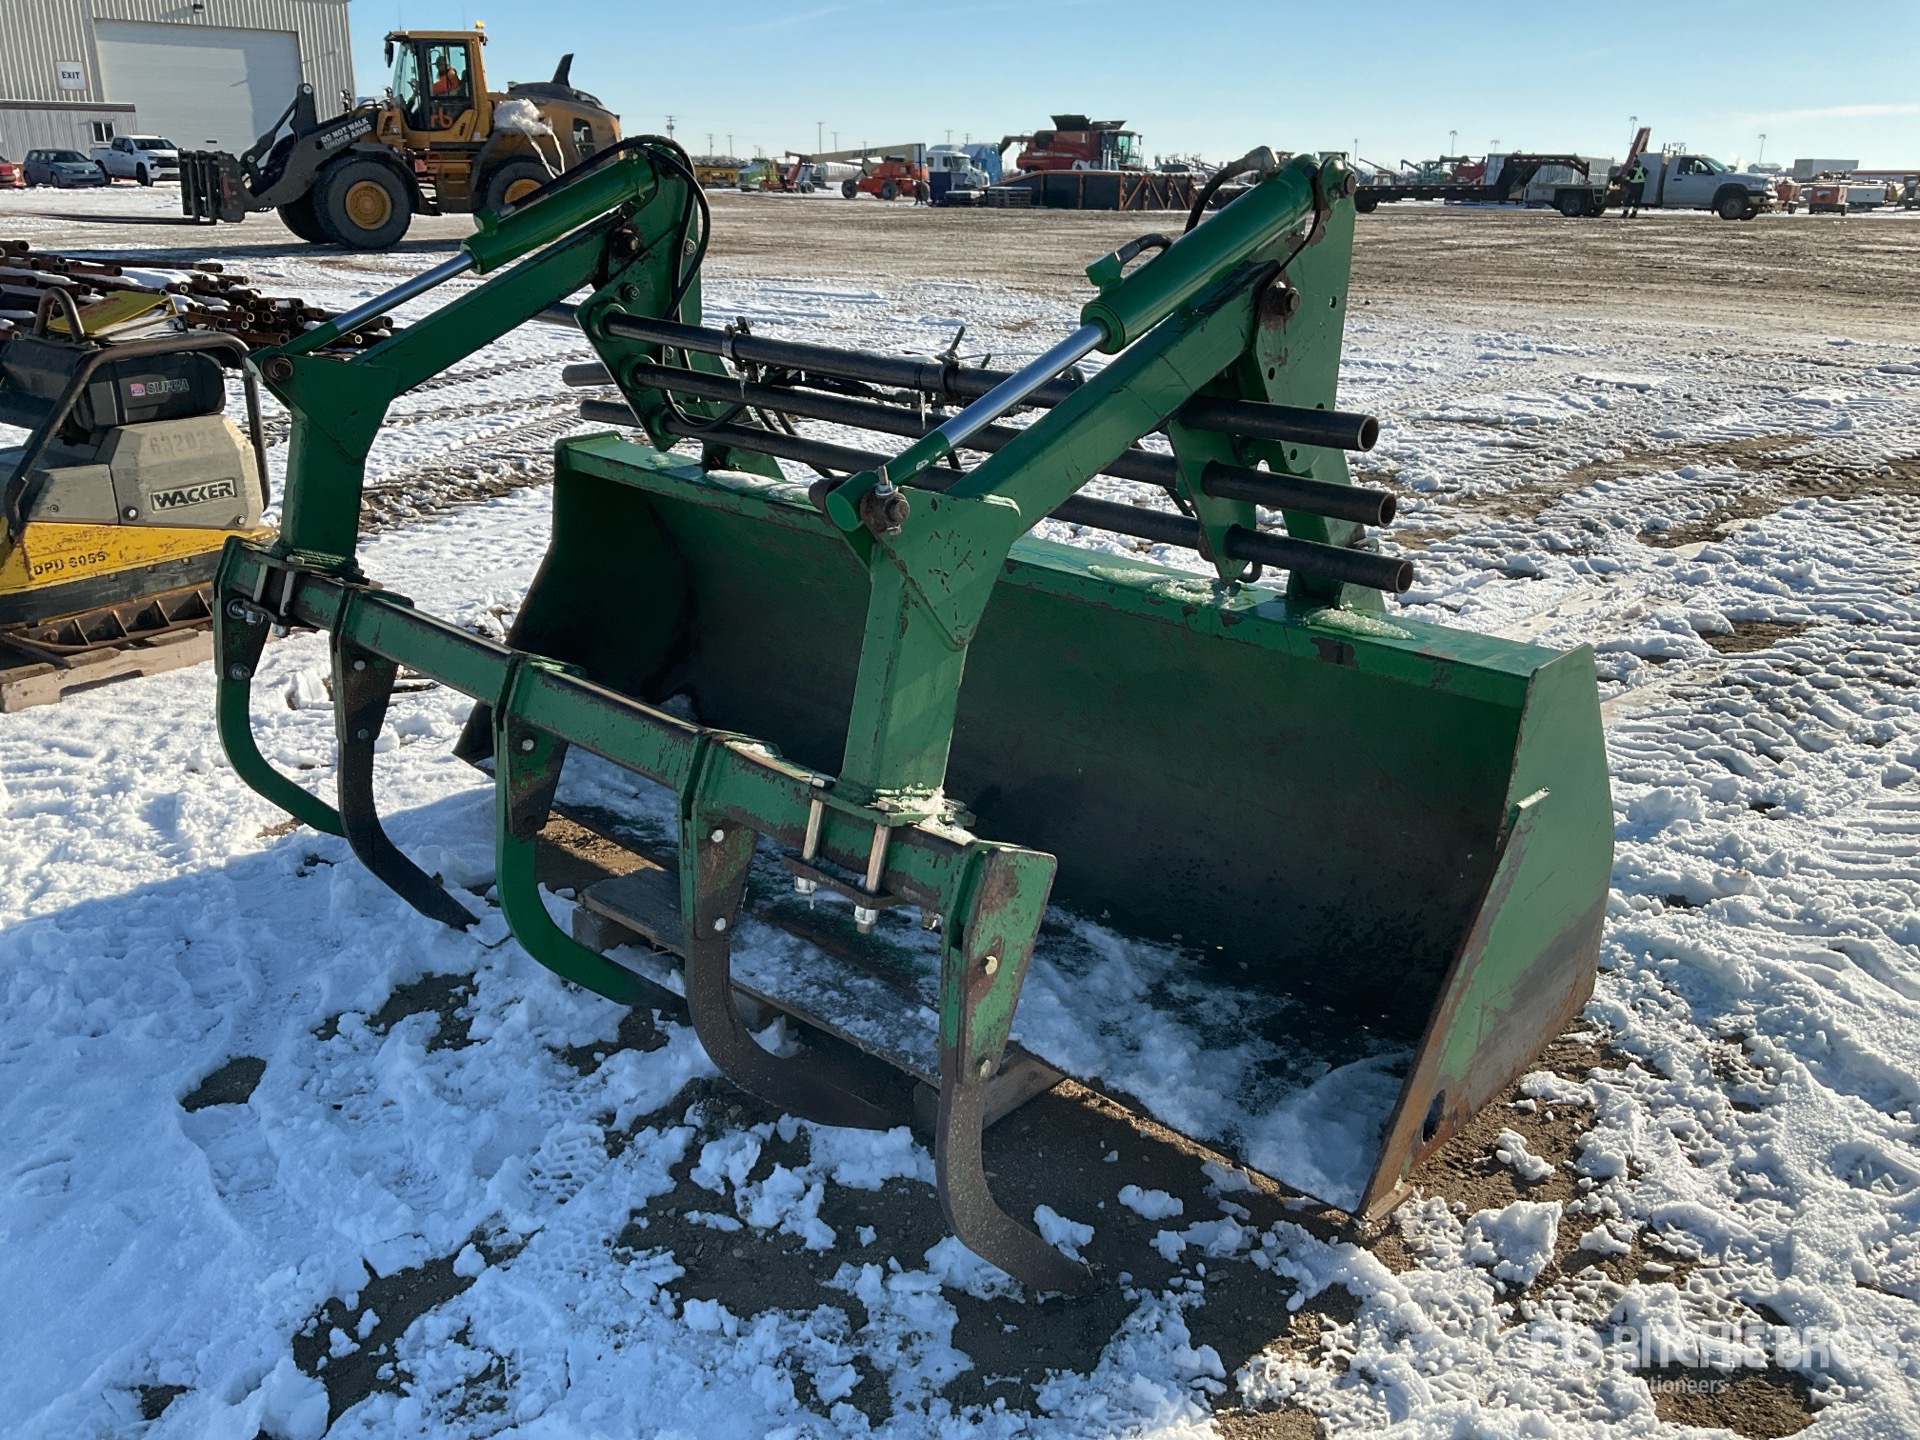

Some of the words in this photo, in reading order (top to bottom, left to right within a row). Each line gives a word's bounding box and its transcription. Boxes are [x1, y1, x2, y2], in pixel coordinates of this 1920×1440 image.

[61, 71, 80, 79] EXIT
[430, 106, 453, 128] rb
[320, 133, 332, 143] DO
[331, 126, 348, 137] NOT
[347, 116, 369, 130] WALK
[323, 134, 350, 149] UNDER
[350, 124, 372, 139] ARMS
[146, 378, 190, 395] SUPRA
[153, 482, 233, 508] WACKER
[33, 558, 64, 575] DPU
